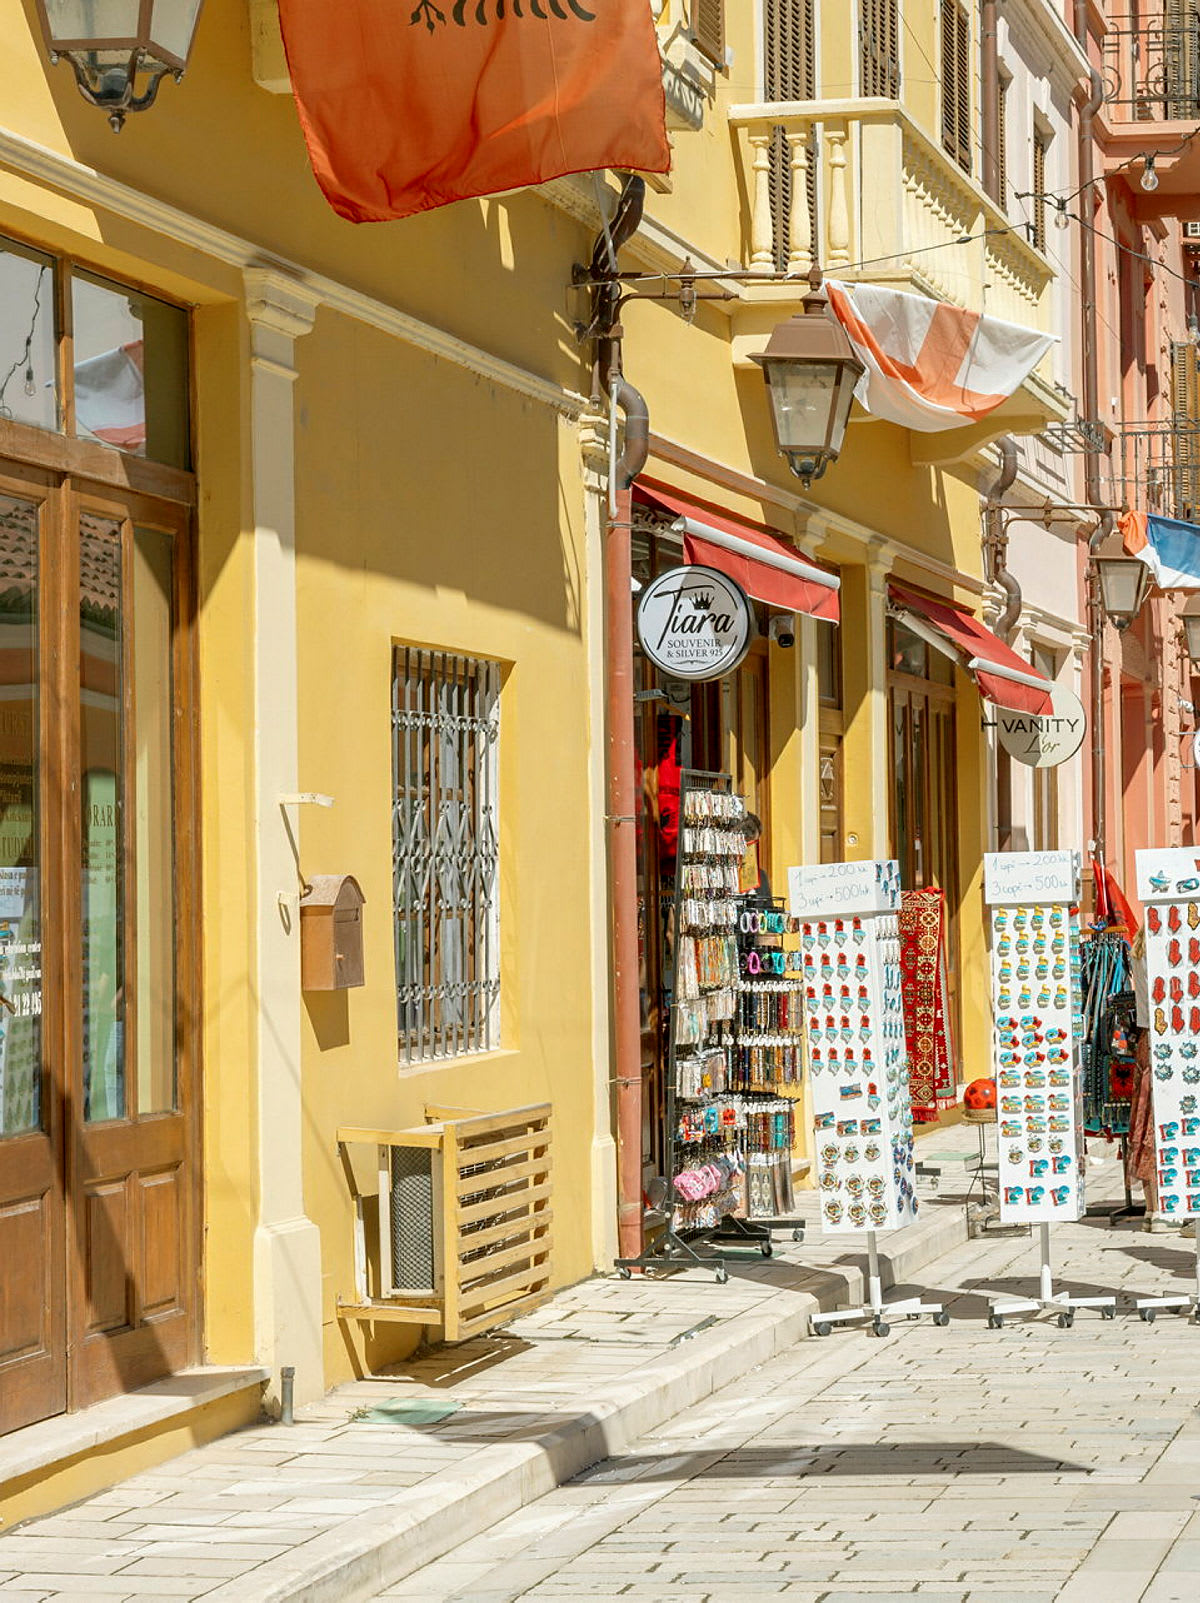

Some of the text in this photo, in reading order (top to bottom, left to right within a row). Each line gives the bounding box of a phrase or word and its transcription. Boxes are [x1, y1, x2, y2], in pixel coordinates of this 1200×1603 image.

[654, 585, 735, 650] Tiara
[667, 638, 721, 649] SOUVENIR
[667, 648, 723, 658] & SILVER 925
[1002, 718, 1080, 733] VANITY
[828, 863, 856, 878] 200
[1033, 874, 1059, 891] 500
[834, 884, 860, 903] 500
